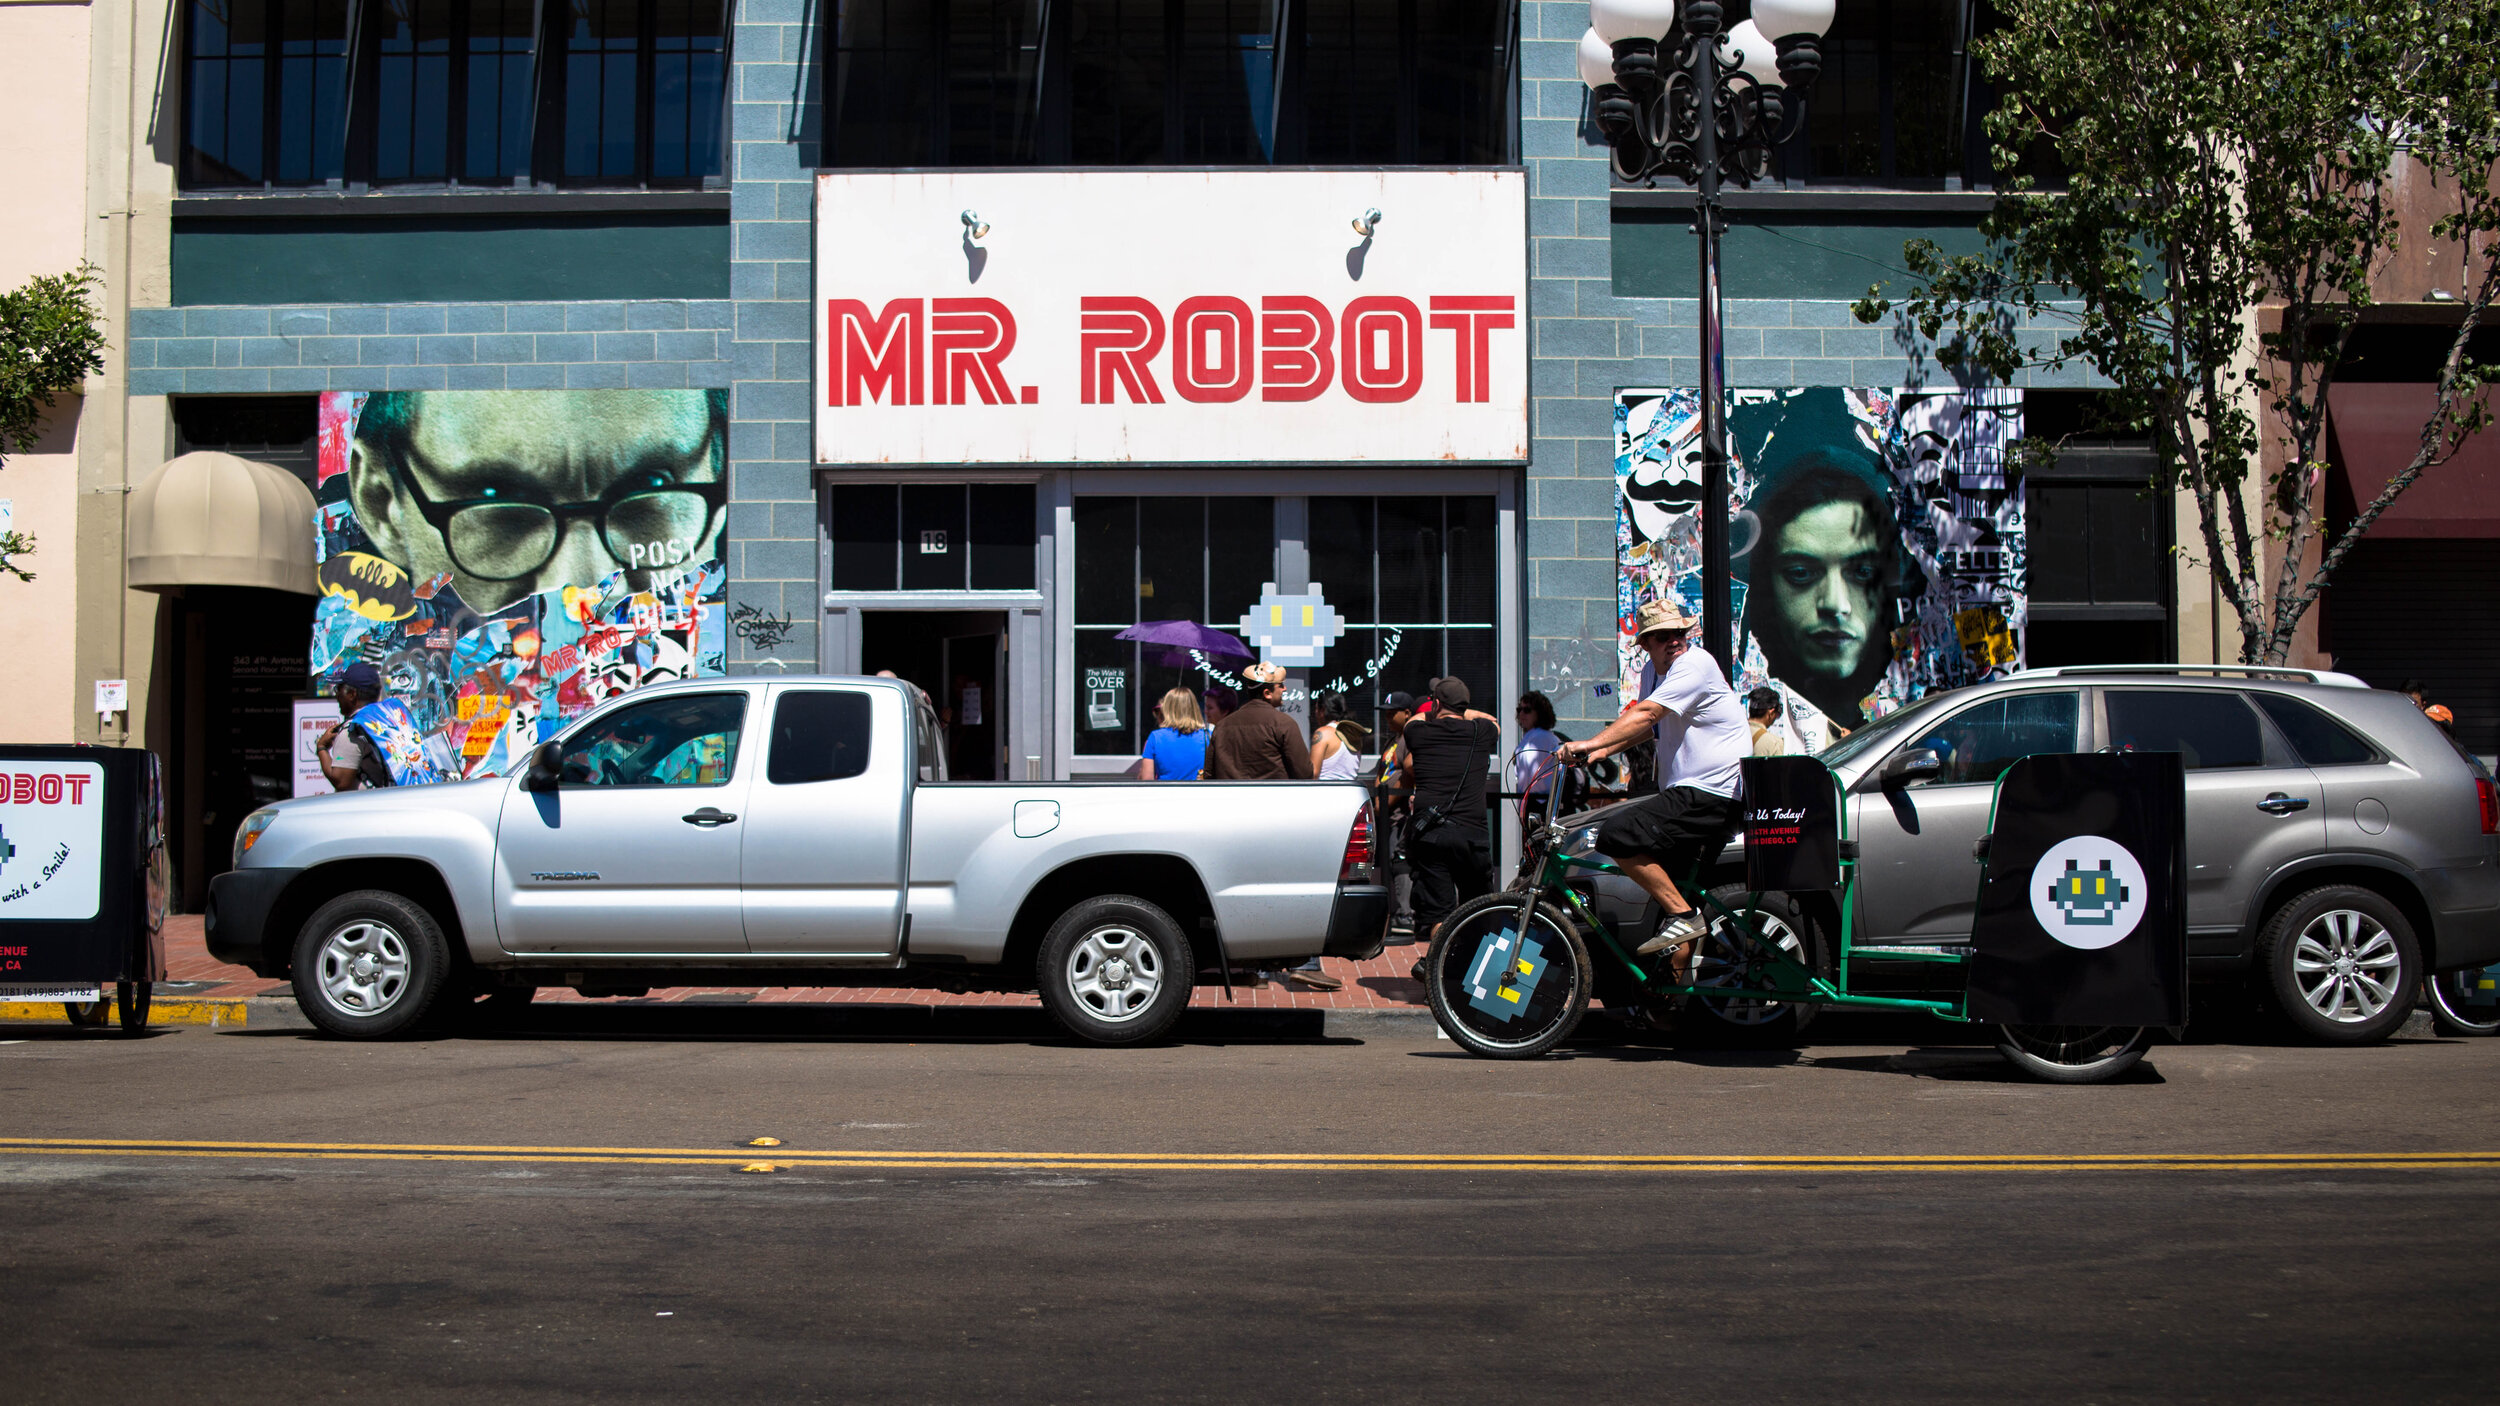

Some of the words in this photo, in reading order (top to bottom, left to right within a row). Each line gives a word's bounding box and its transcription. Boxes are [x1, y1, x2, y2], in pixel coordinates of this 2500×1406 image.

[828, 297, 1039, 407] MR.
[1080, 295, 1515, 404] ROBOT
[923, 532, 946, 551] 18
[629, 536, 699, 570] POST
[1955, 552, 2010, 571] ELLE
[651, 568, 687, 597] NO
[631, 595, 710, 631] BILLS
[270, 656, 304, 665] Avenue
[541, 644, 586, 677] MR.
[1189, 649, 1243, 690] mputer
[1310, 676, 1349, 700] wth
[1353, 676, 1364, 687] a
[1366, 626, 1402, 678] Smile!
[1087, 669, 1100, 677] The
[1101, 669, 1117, 677] Wait
[1086, 677, 1125, 688] OVER
[1593, 683, 1613, 697] YKS
[463, 699, 494, 708] CAH
[1756, 808, 1769, 820] Us
[1772, 807, 1806, 823] Today!
[1770, 826, 1801, 835] AVENUE
[1760, 837, 1785, 845] DIEGO,
[1786, 836, 1797, 844] CA
[2, 883, 29, 902] with
[33, 881, 42, 889] a
[42, 842, 71, 881] Smile!
[531, 871, 601, 881] TACOMA
[6, 960, 22, 970] CA
[24, 987, 92, 997] (619)885-1782
